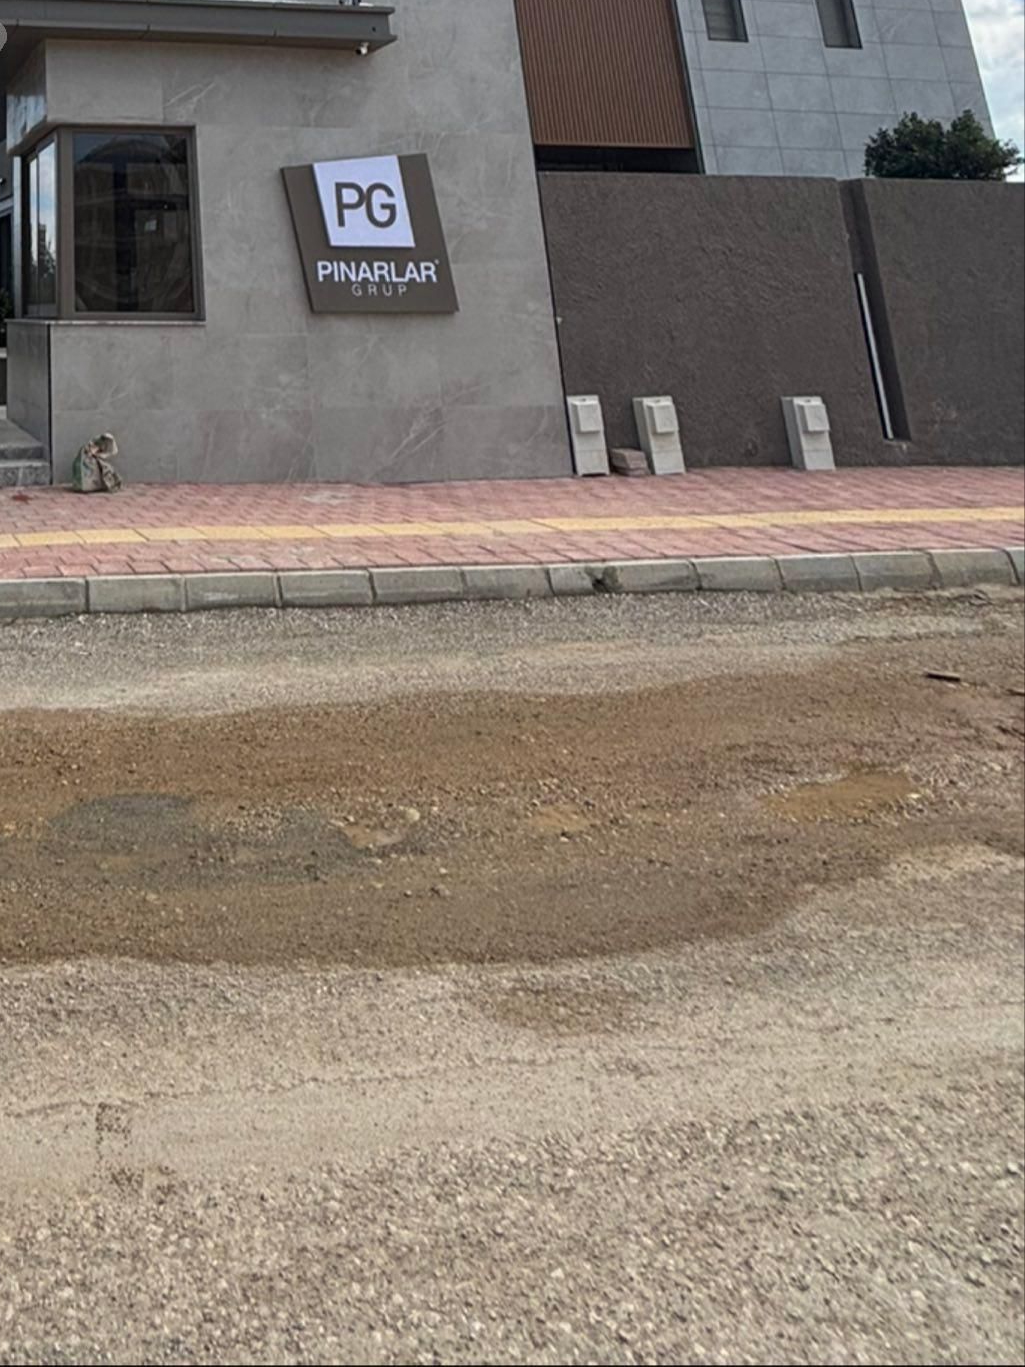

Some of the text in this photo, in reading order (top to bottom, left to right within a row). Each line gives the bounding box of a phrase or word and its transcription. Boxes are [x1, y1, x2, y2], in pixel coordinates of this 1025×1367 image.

[334, 182, 397, 228] PG
[317, 261, 437, 282] PINARLAR
[352, 284, 407, 296] GRUP
